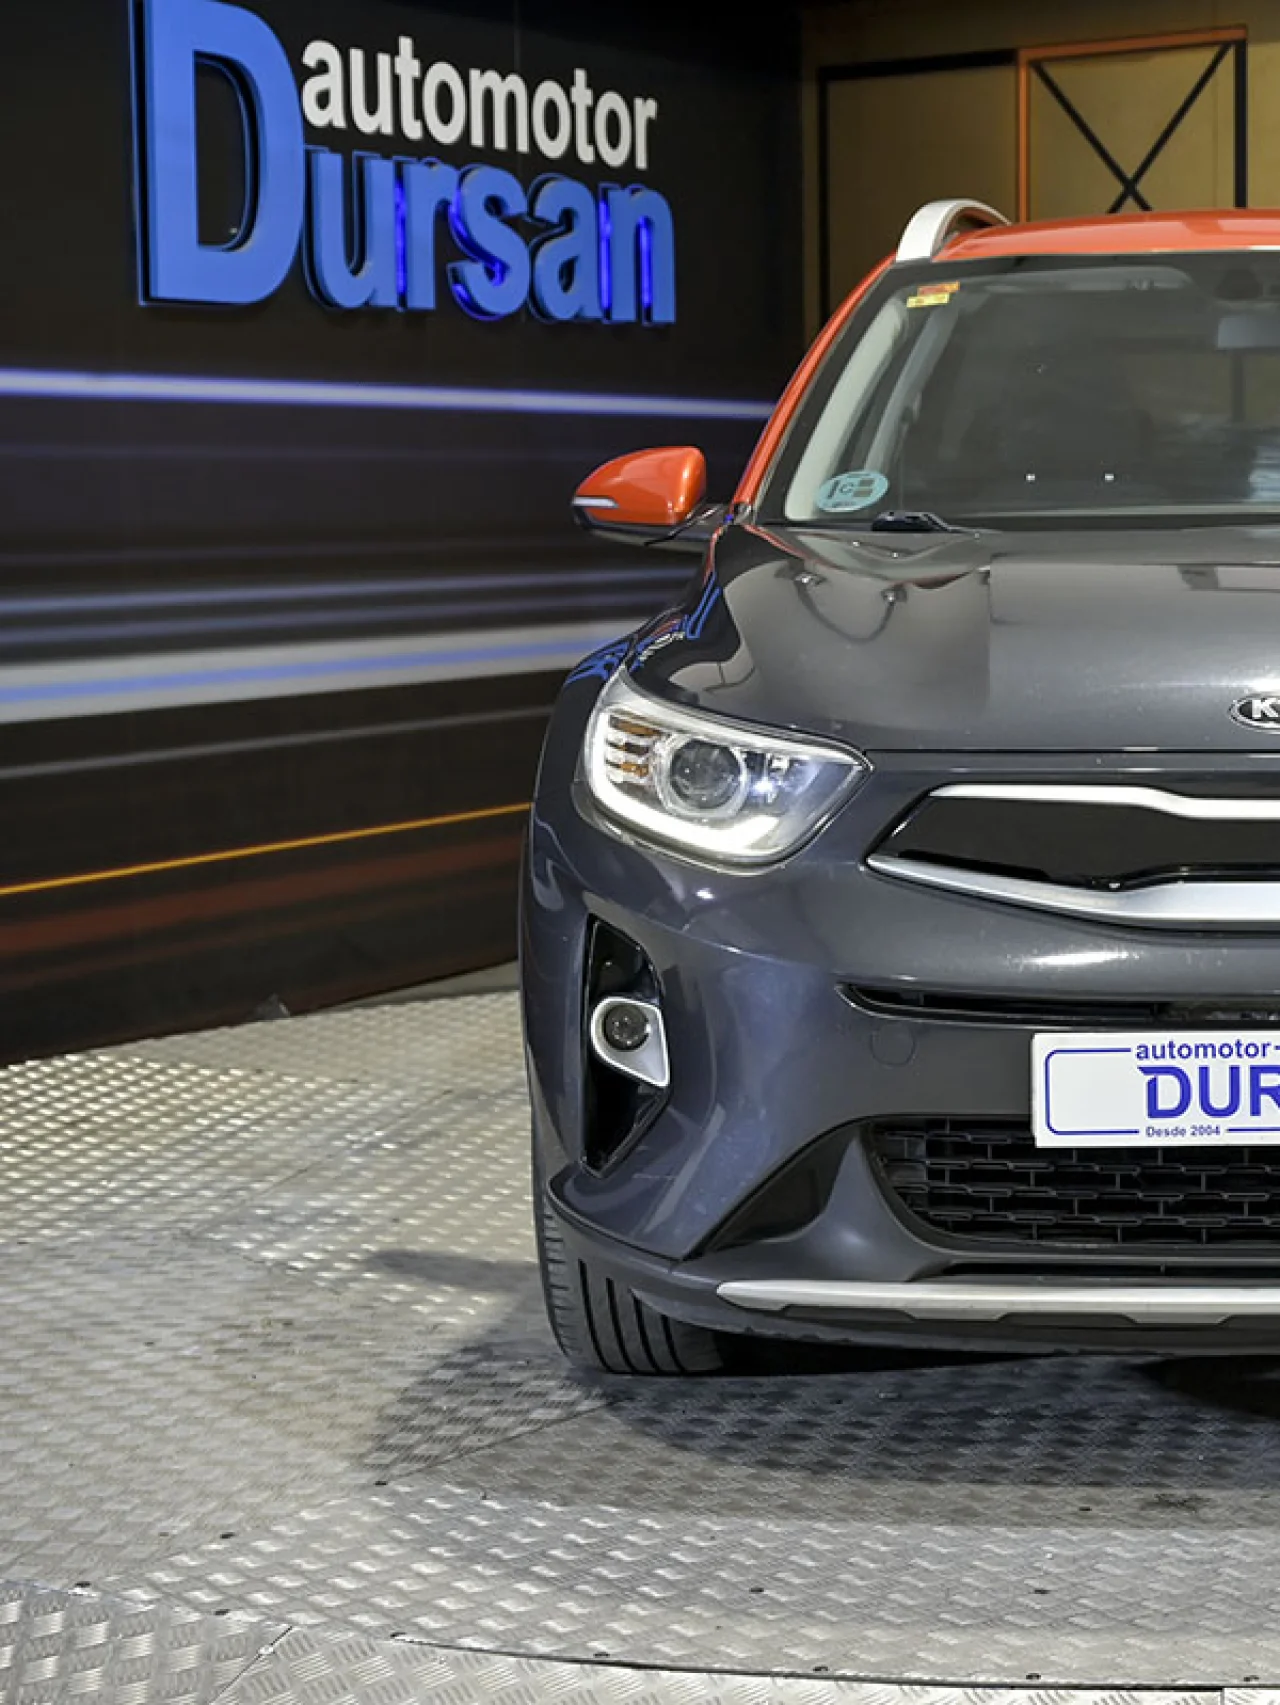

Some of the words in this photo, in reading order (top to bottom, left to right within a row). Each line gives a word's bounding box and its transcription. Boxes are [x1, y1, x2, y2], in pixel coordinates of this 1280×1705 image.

[301, 36, 657, 169] automotor
[131, 0, 676, 324] Dursan
[1136, 1040, 1272, 1059] automotor
[1146, 1126, 1186, 1137] Desde
[1190, 1124, 1221, 1136] 2004
